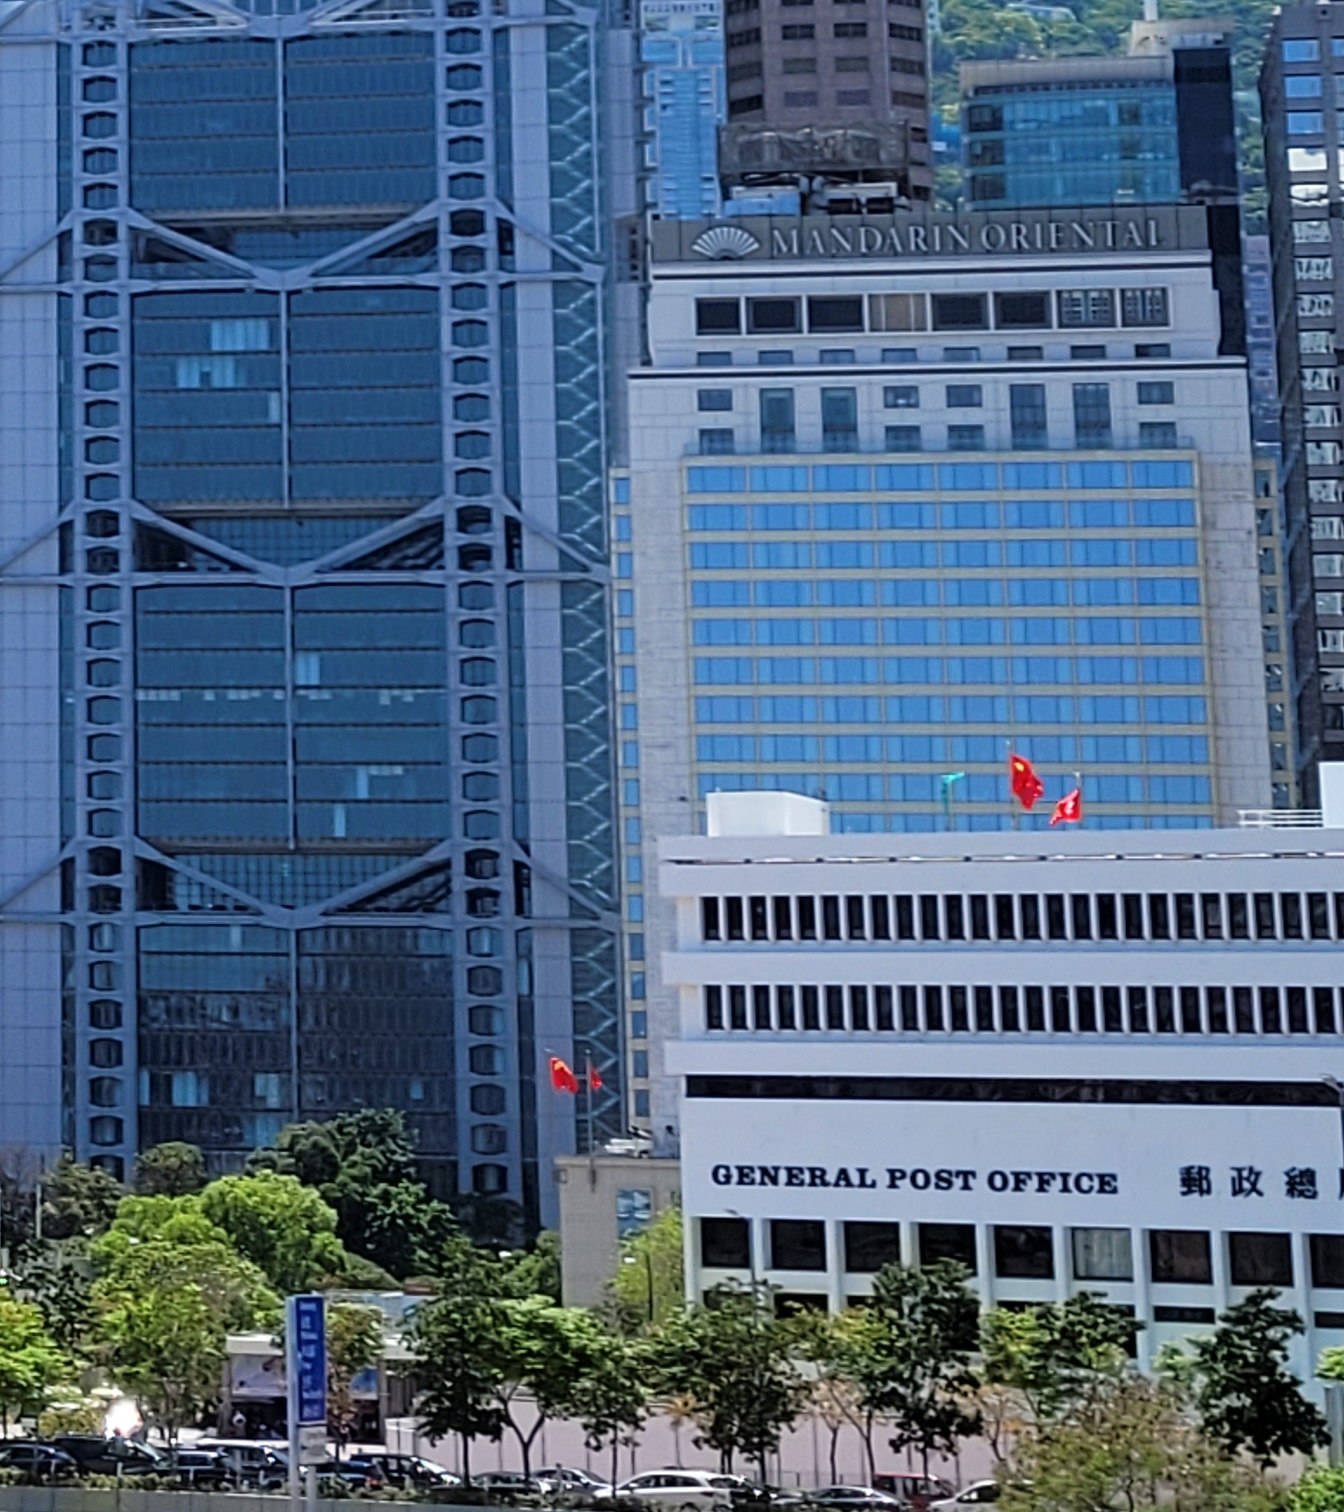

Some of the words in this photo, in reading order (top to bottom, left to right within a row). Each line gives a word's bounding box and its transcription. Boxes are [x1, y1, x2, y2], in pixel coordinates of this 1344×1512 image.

[771, 221, 971, 256] MANDARIN
[981, 218, 1165, 252] ORIENTAL
[711, 1164, 877, 1189] GENERAL
[884, 1167, 977, 1191] POST
[986, 1169, 1119, 1195] OFFICE
[1179, 1165, 1344, 1200] 郵政總
